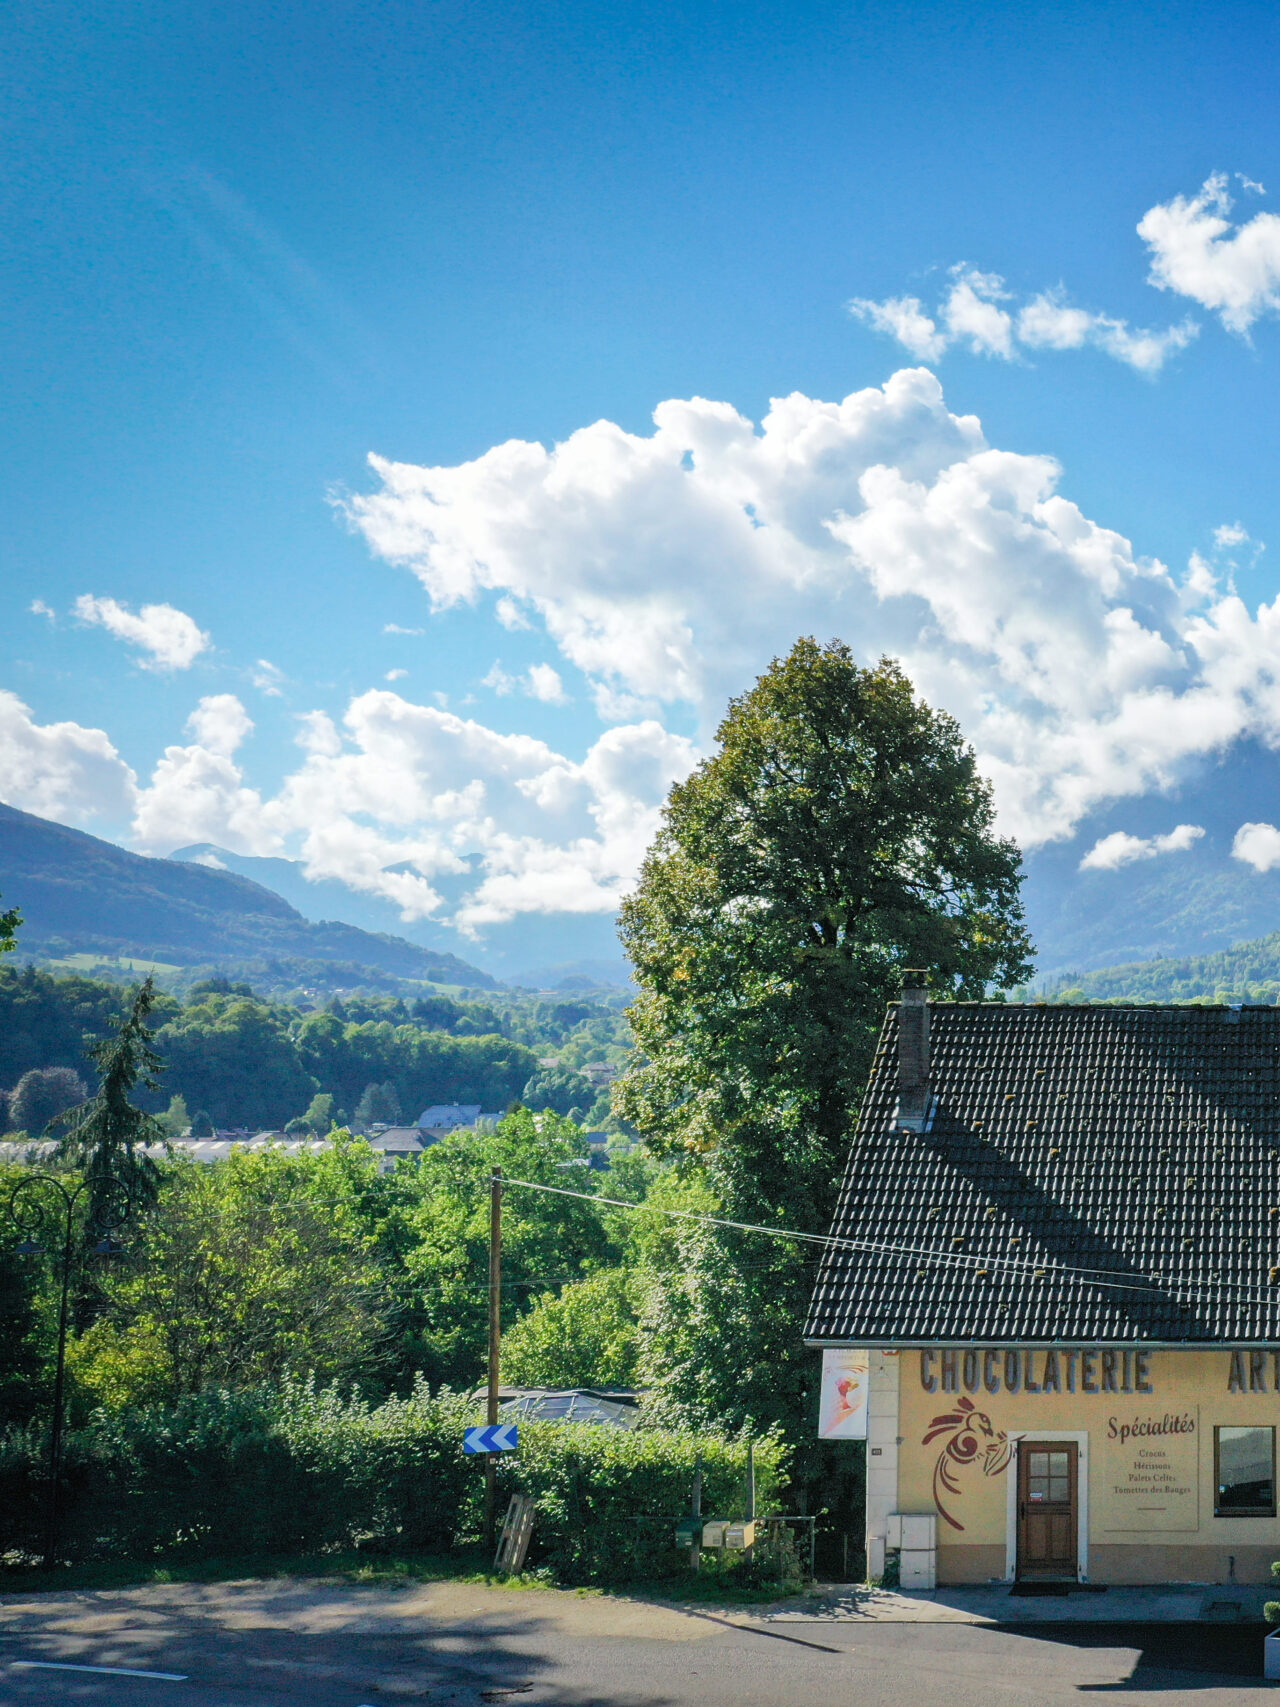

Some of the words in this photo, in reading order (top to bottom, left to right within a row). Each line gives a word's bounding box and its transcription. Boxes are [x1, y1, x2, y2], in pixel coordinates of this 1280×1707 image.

[919, 1349, 1153, 1394] CHOCOLATERIE
[1107, 1412, 1195, 1445] Spécialités
[1139, 1449, 1166, 1458] Crocus
[1133, 1461, 1171, 1470] Hérissons
